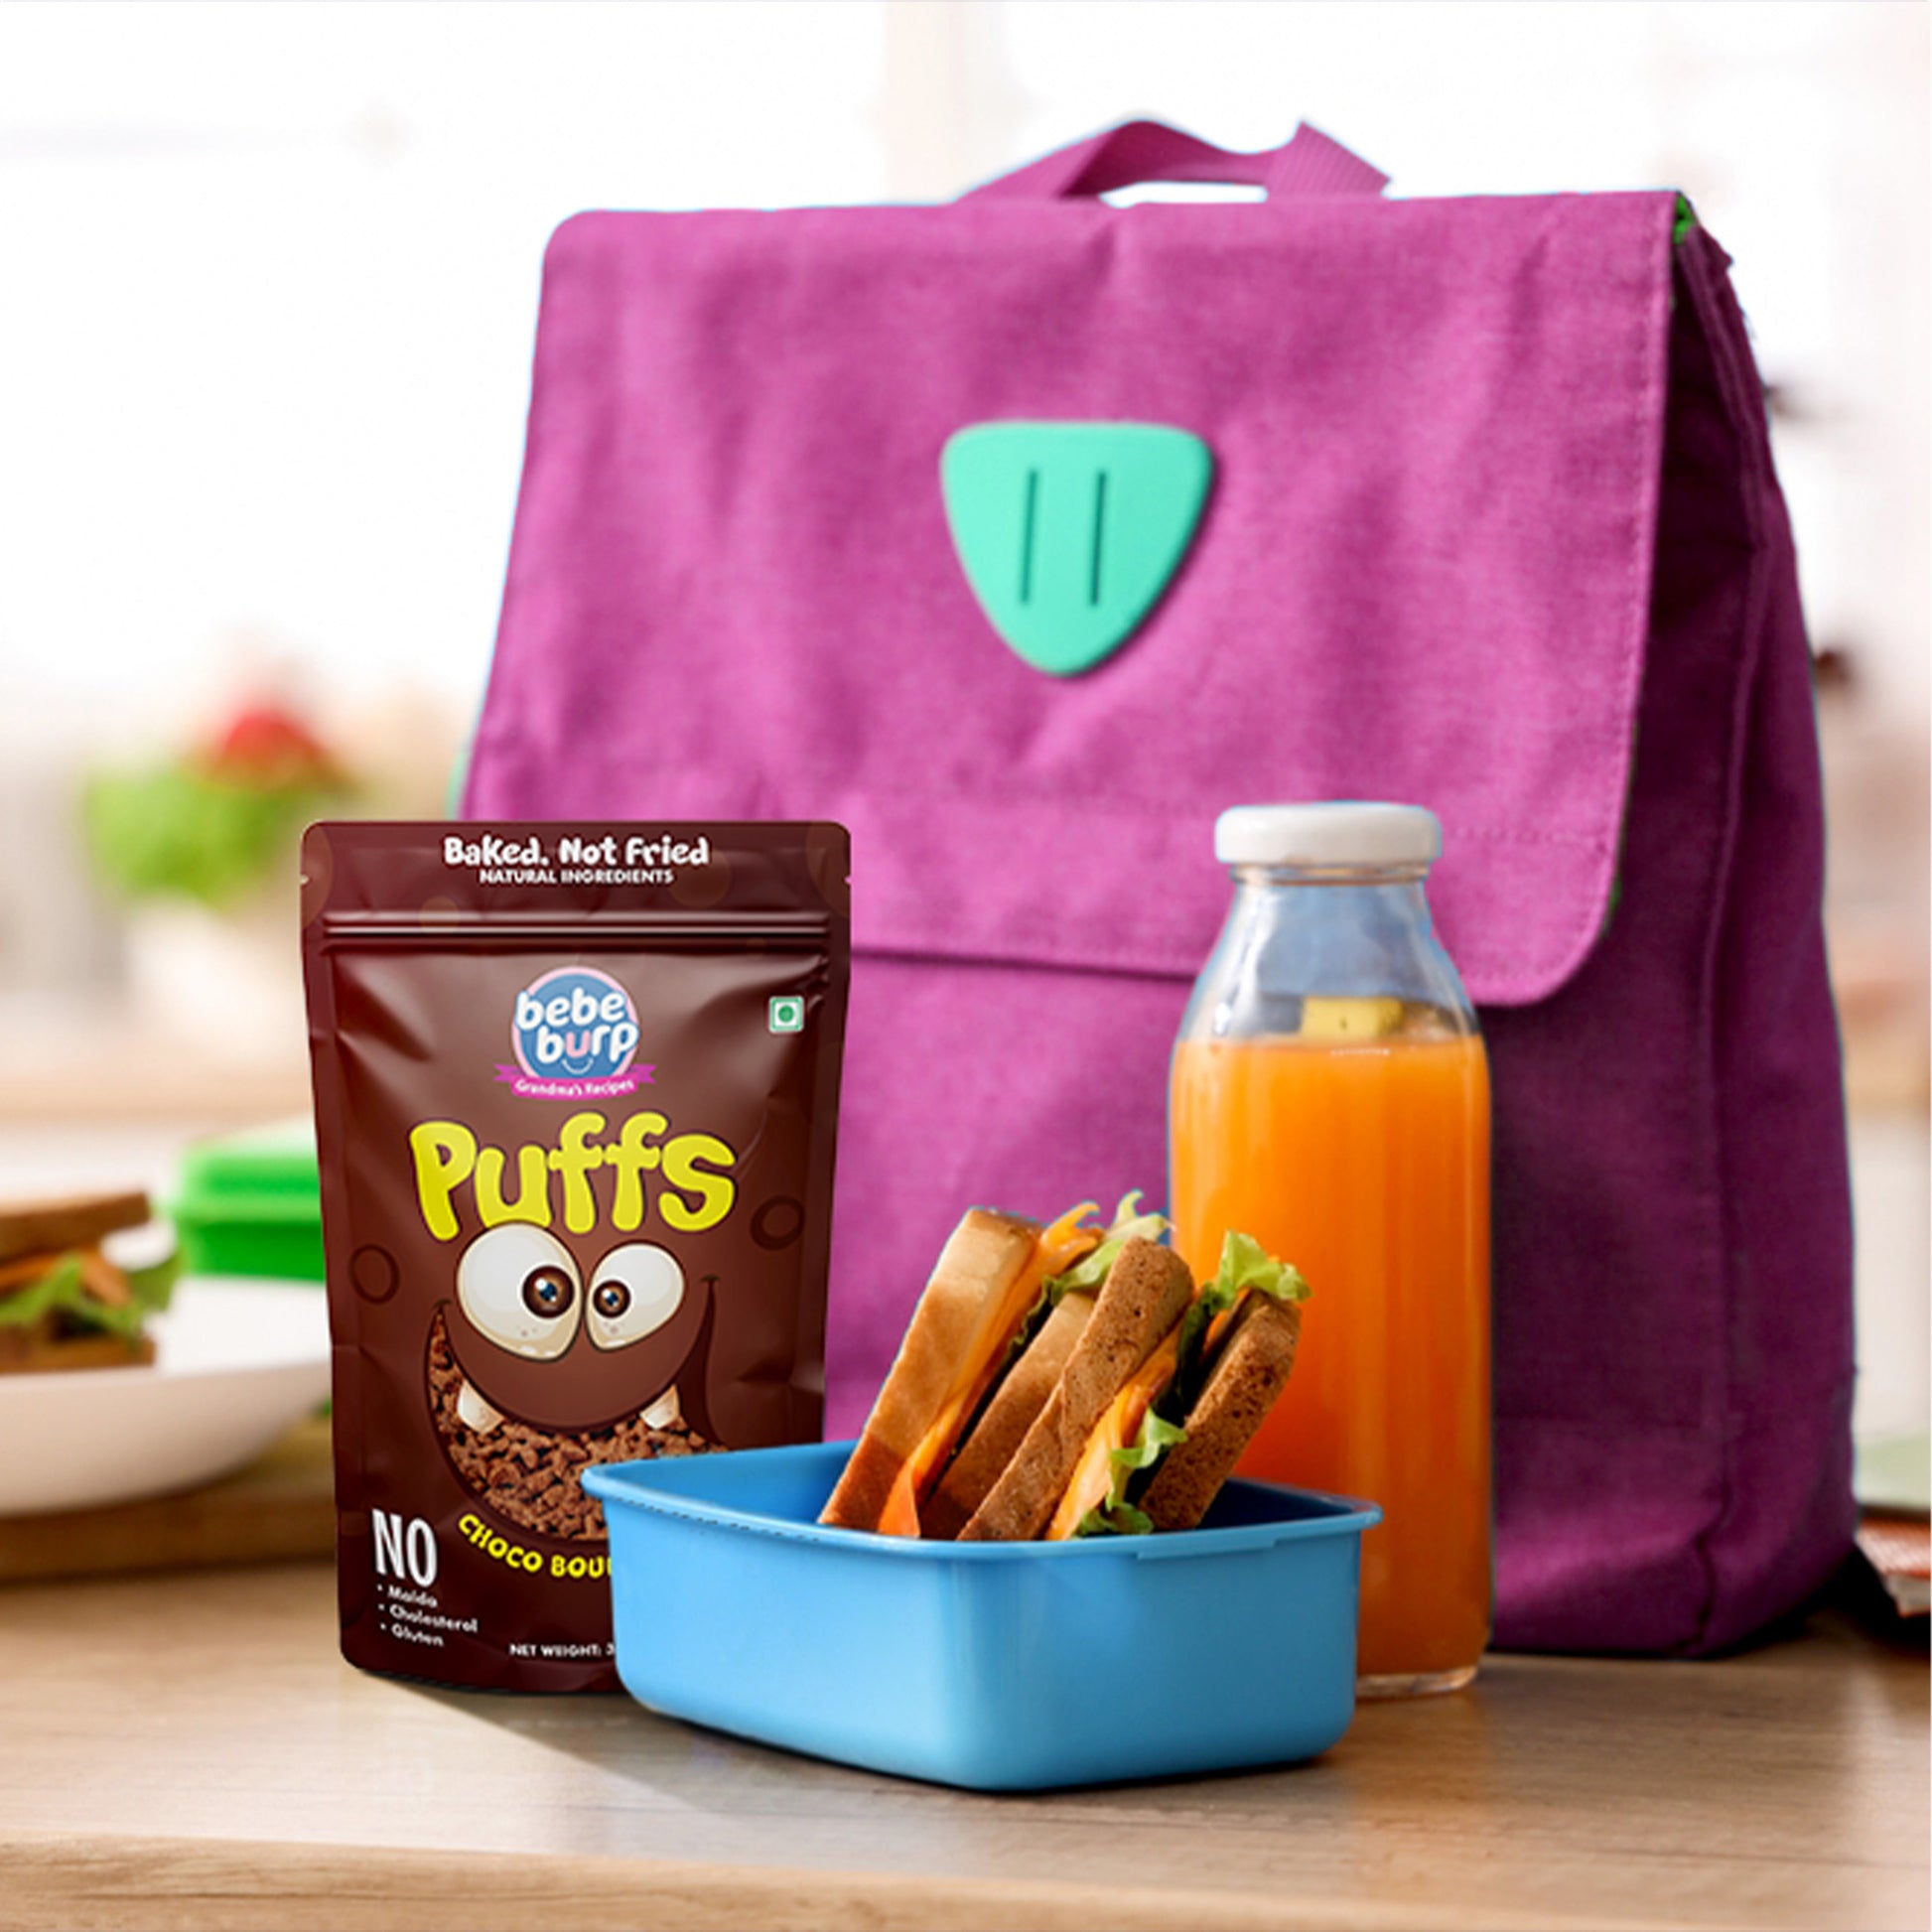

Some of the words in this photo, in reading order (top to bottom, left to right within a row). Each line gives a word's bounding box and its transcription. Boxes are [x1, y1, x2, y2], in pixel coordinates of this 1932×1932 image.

[559, 836, 618, 866] Not
[480, 869, 557, 884] NATURAL
[561, 869, 674, 884] INGREDIENTS
[515, 987, 626, 1031] bebe
[536, 1022, 640, 1064] burp
[586, 1079, 634, 1095] Recipes
[409, 1111, 736, 1241] Puffs
[372, 1508, 438, 1587] NO
[458, 1513, 544, 1574] CHOCO
[388, 1585, 438, 1608] Maida
[389, 1603, 479, 1633] Cholesterol
[391, 1623, 444, 1647] Gluten
[508, 1643, 536, 1656] NET
